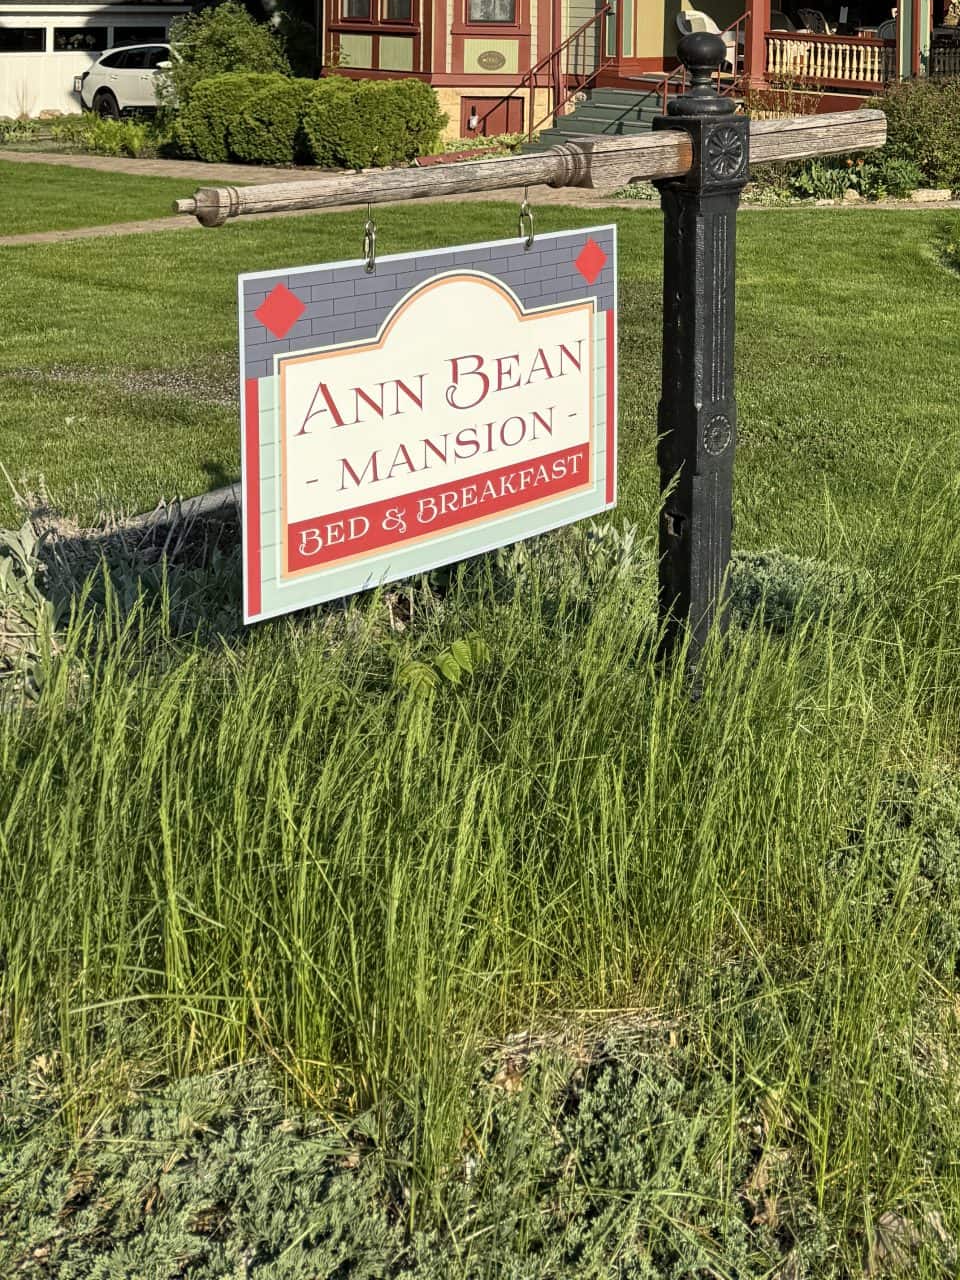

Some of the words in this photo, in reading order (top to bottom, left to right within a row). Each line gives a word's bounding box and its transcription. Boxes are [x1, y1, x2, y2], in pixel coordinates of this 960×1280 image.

[294, 374, 429, 437] ANN
[444, 339, 584, 410] BEAN
[336, 406, 556, 492] MANSION
[298, 516, 370, 556] BED
[381, 508, 407, 534] &
[416, 453, 584, 524] BREAKFAST
